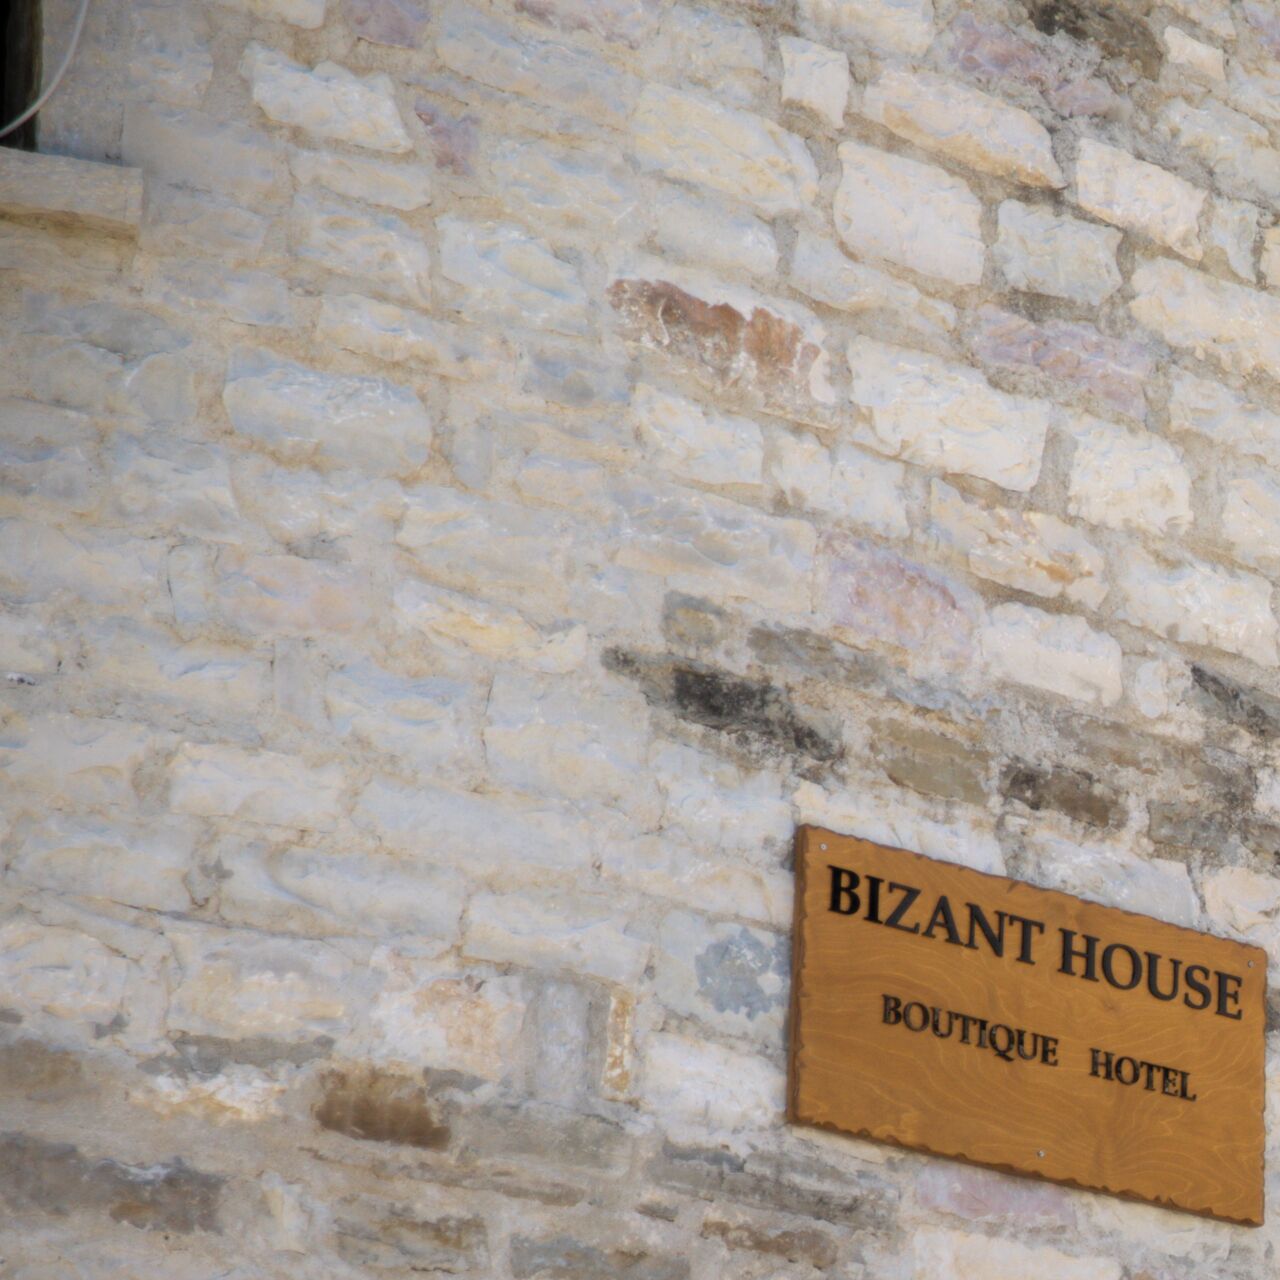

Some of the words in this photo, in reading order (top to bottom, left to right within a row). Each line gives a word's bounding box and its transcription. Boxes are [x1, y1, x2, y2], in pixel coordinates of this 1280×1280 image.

[827, 865, 1045, 965] BIZANT
[1057, 928, 1244, 1021] HOUSE
[882, 994, 1060, 1067] BOUTIQUE
[1089, 1047, 1197, 1101] HOTEL
